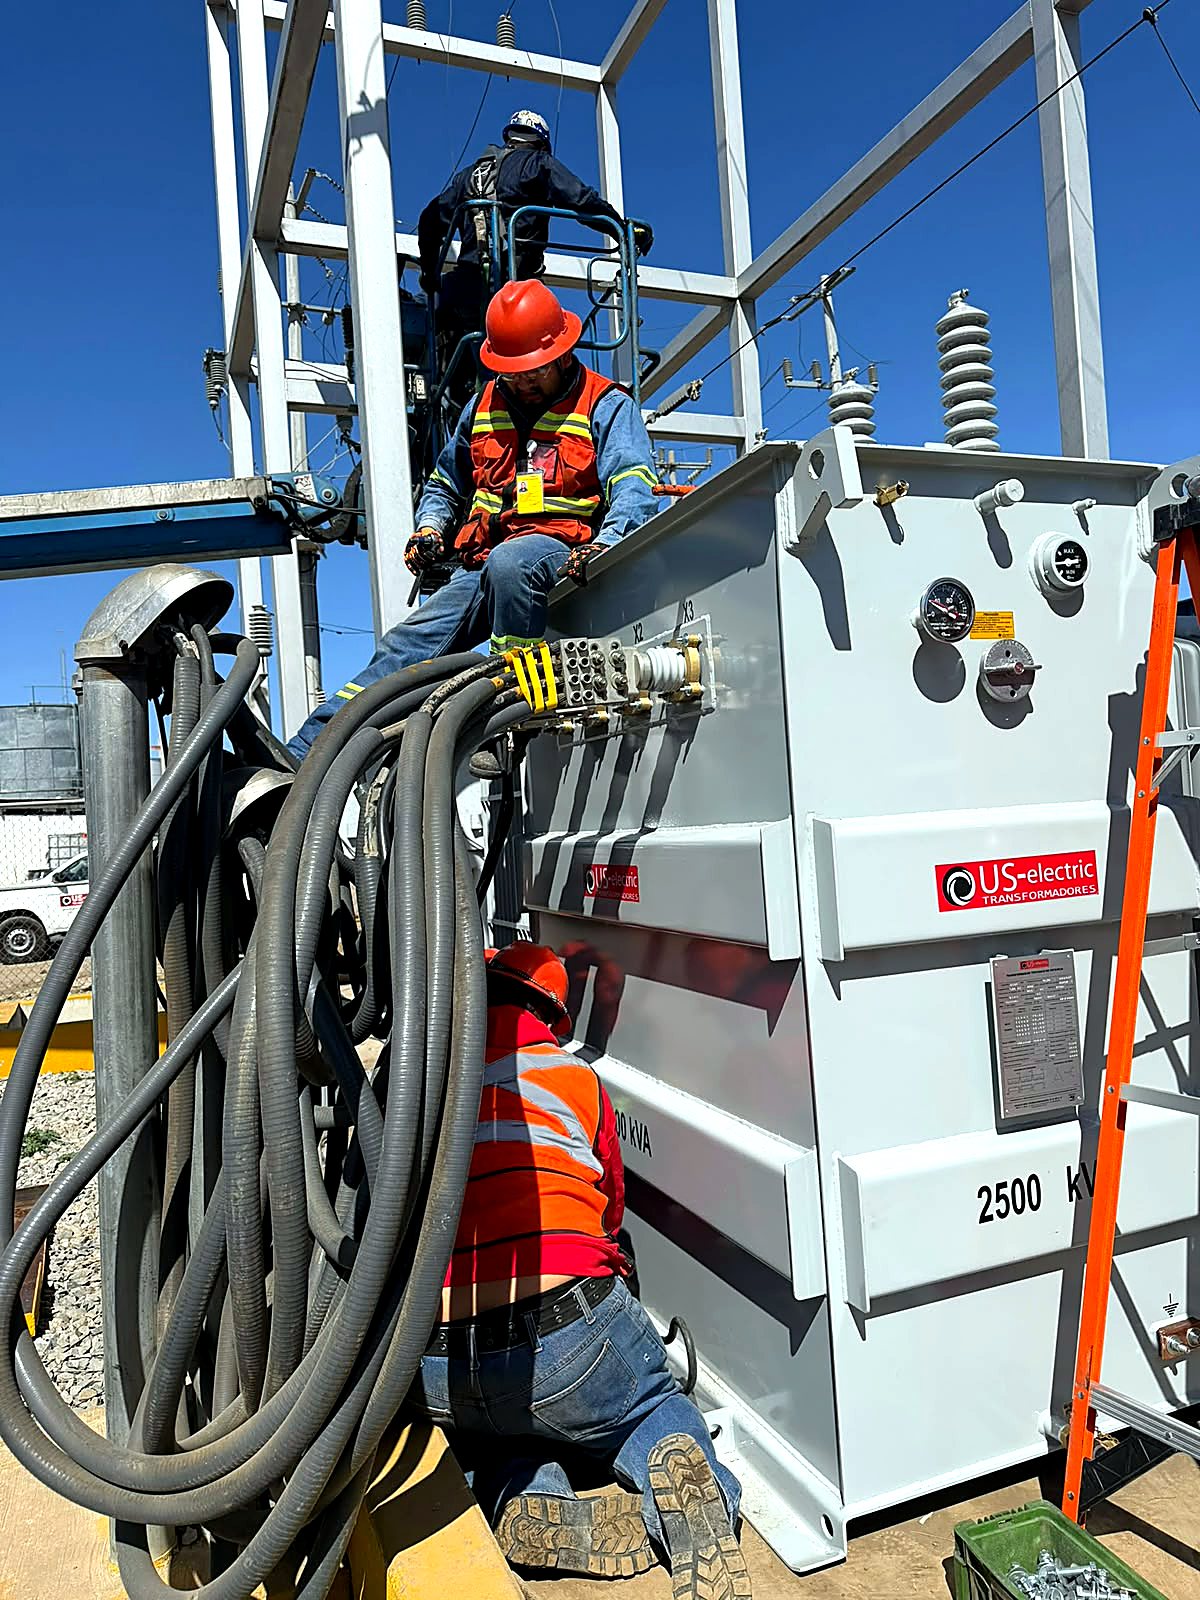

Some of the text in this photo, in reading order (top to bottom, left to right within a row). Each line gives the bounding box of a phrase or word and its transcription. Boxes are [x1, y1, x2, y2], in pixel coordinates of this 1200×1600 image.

[682, 599, 695, 624] X3
[632, 622, 644, 645] X2
[978, 858, 1094, 894] US-electric
[982, 884, 1097, 905] TRANSFORMADORES
[629, 1116, 652, 1158] kVA
[977, 1159, 1098, 1225] 2500 kV
